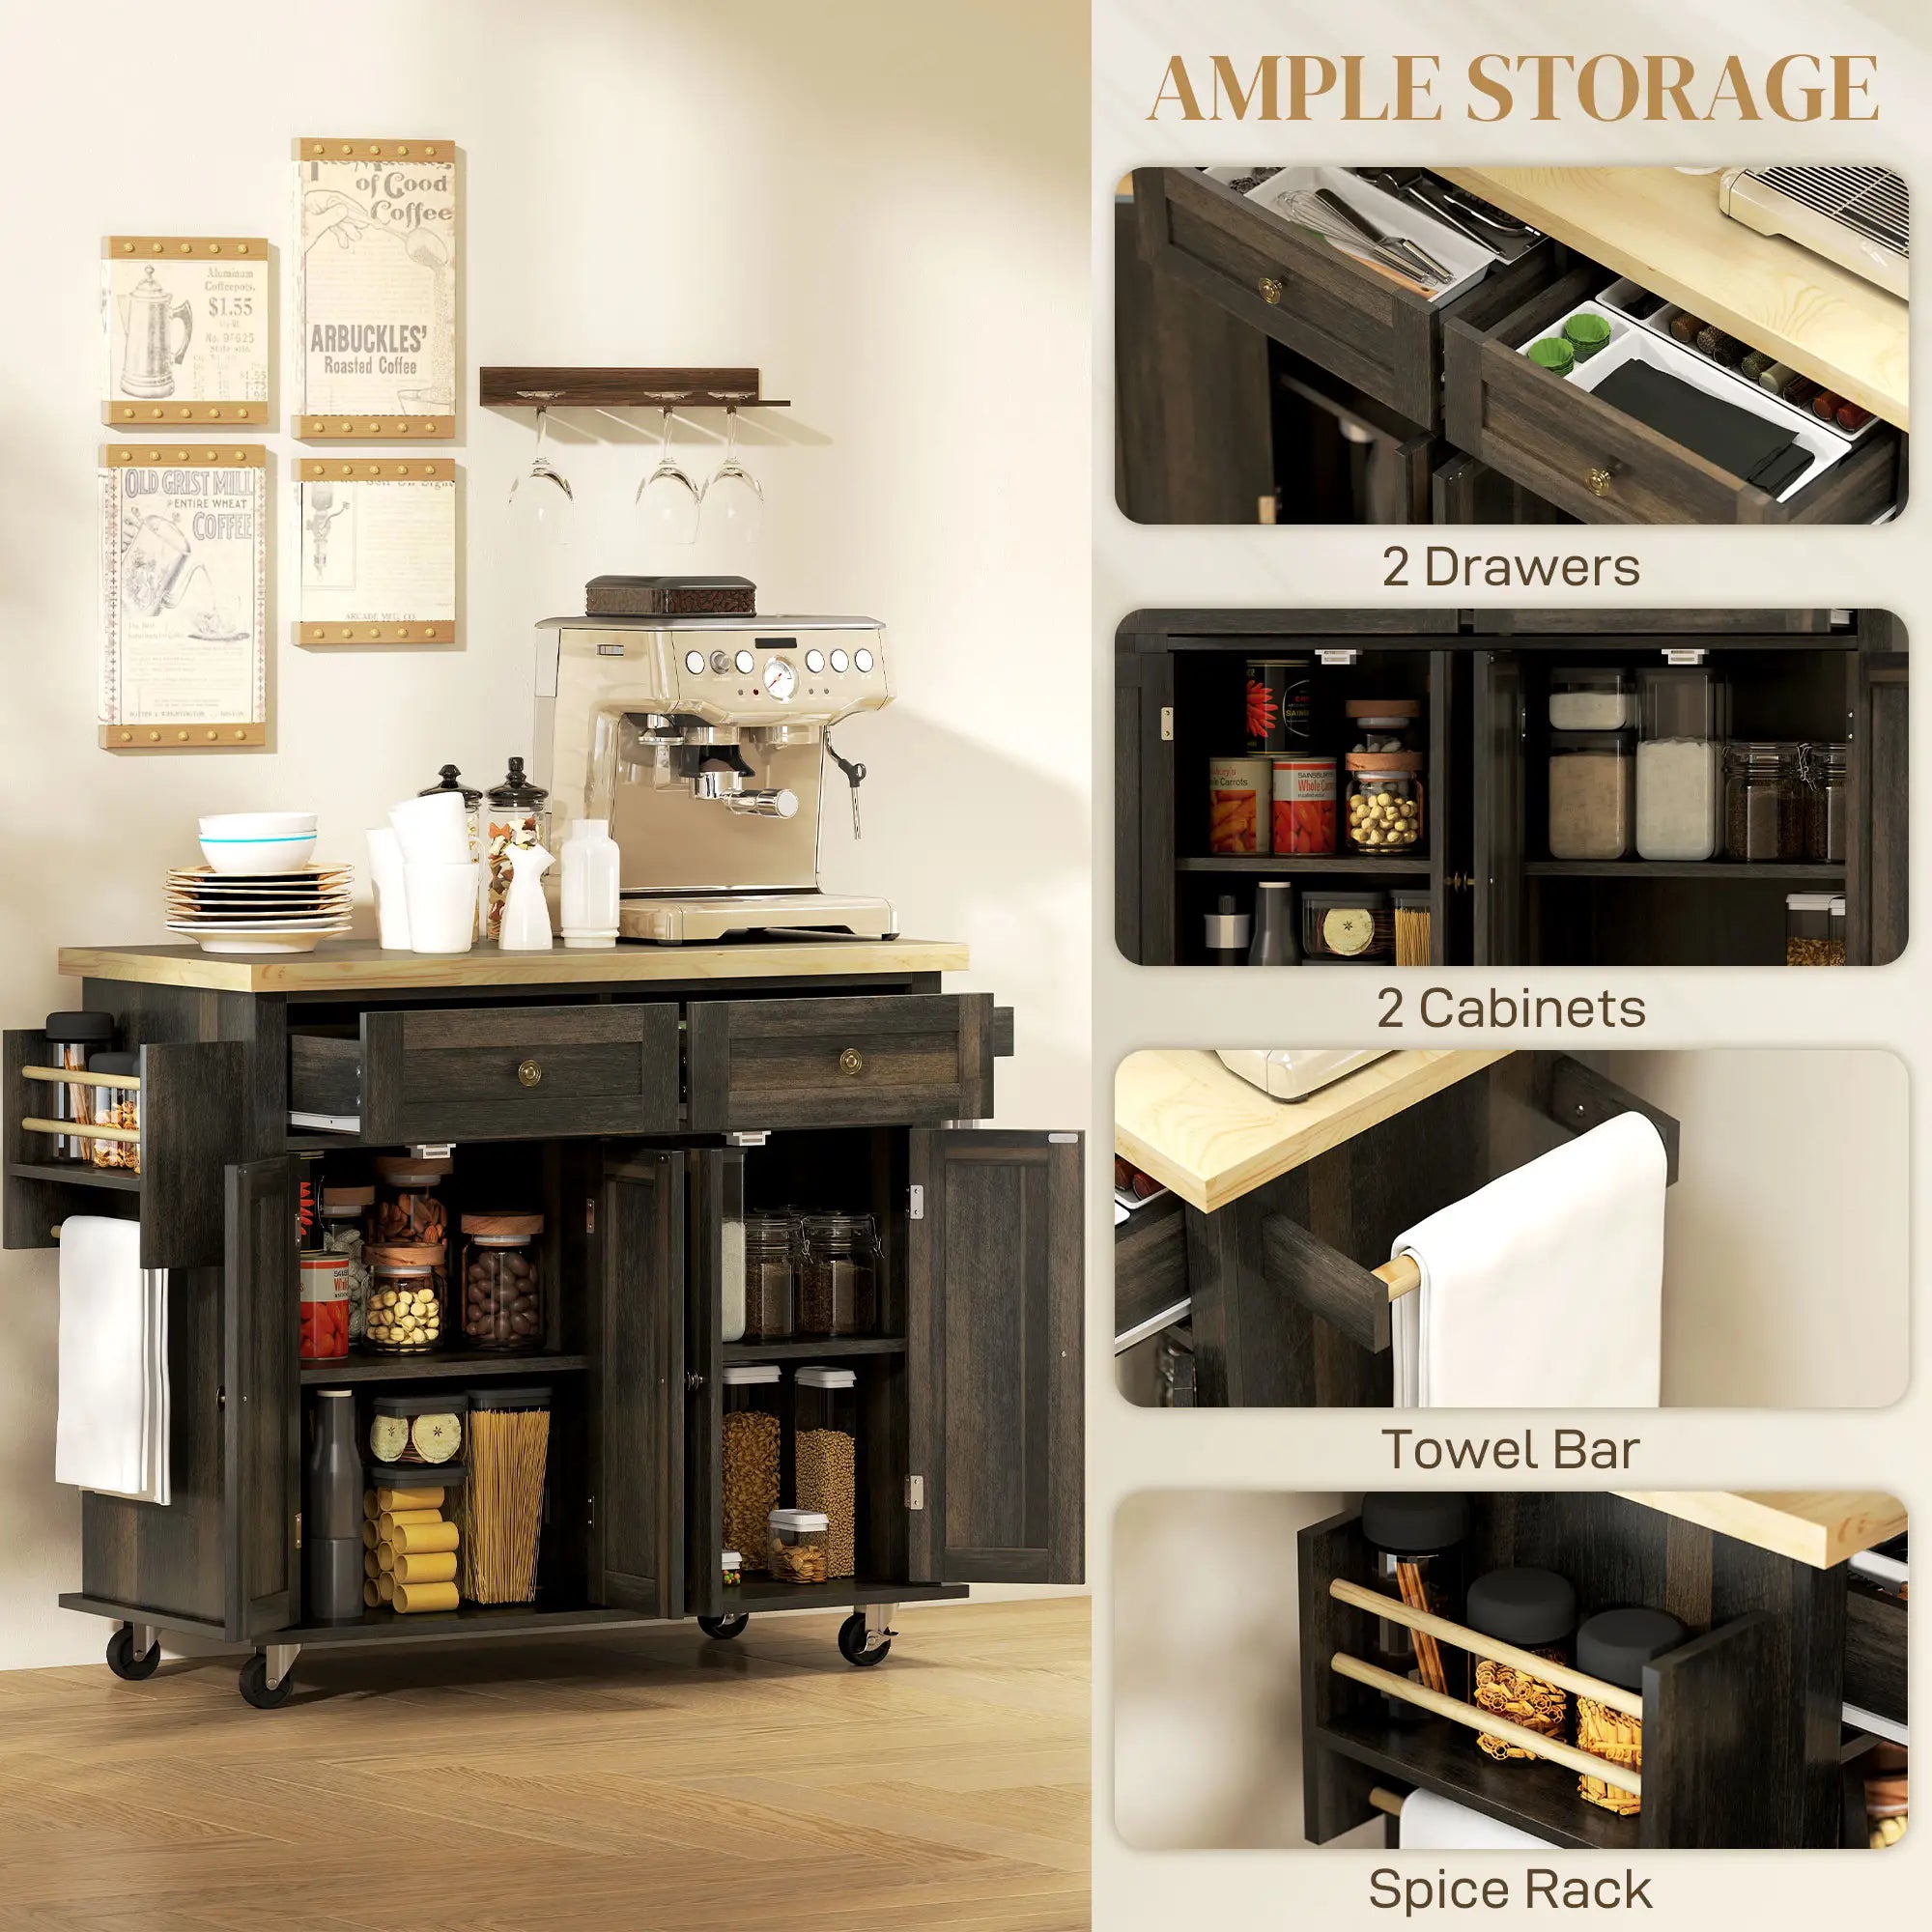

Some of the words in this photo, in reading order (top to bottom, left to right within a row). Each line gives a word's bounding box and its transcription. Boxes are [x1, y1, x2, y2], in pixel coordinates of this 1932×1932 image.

[355, 174, 380, 199] of
[384, 171, 447, 199] Good
[370, 200, 453, 228] Coffee
[207, 267, 254, 278] Aluminum
[208, 298, 253, 318] $1.55
[310, 324, 427, 354] ARBUCKLES'
[325, 355, 372, 375] Roasted
[379, 355, 416, 375] Coffee
[125, 469, 159, 498] OLD
[162, 469, 210, 496] GRIST
[213, 470, 253, 496] MILL
[174, 498, 209, 509] ENTIRE
[212, 498, 247, 509] WHEAT
[192, 511, 252, 541] COFFEE
[1220, 777, 1248, 786] Carrots
[1297, 779, 1321, 792] Whole
